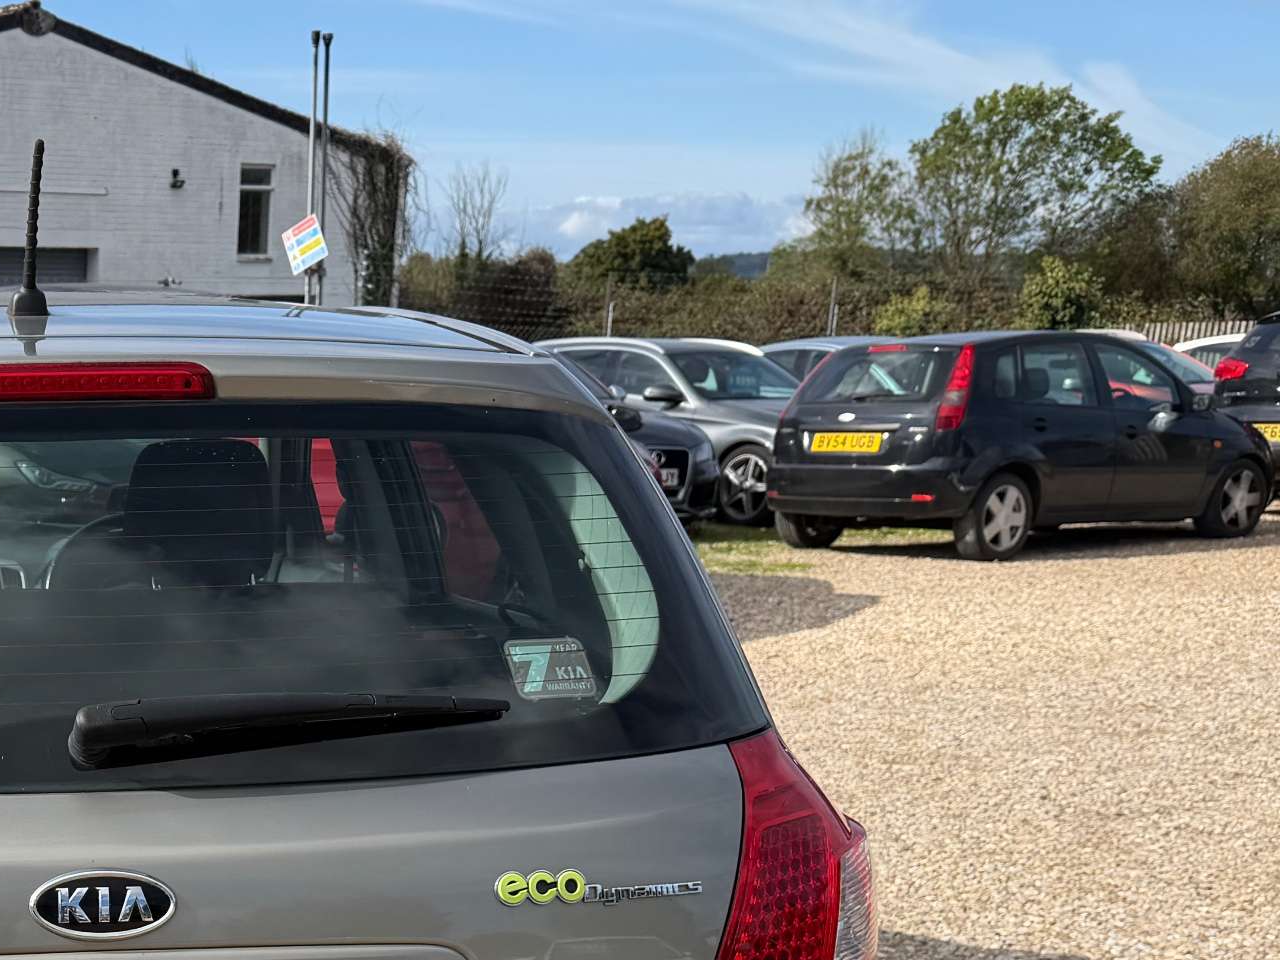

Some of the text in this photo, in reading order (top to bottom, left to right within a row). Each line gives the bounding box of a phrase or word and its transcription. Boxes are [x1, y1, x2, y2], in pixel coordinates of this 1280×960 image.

[508, 645, 552, 693] 7
[555, 666, 588, 679] KIA
[546, 682, 591, 691] WARRANTY
[55, 886, 154, 924] KIA
